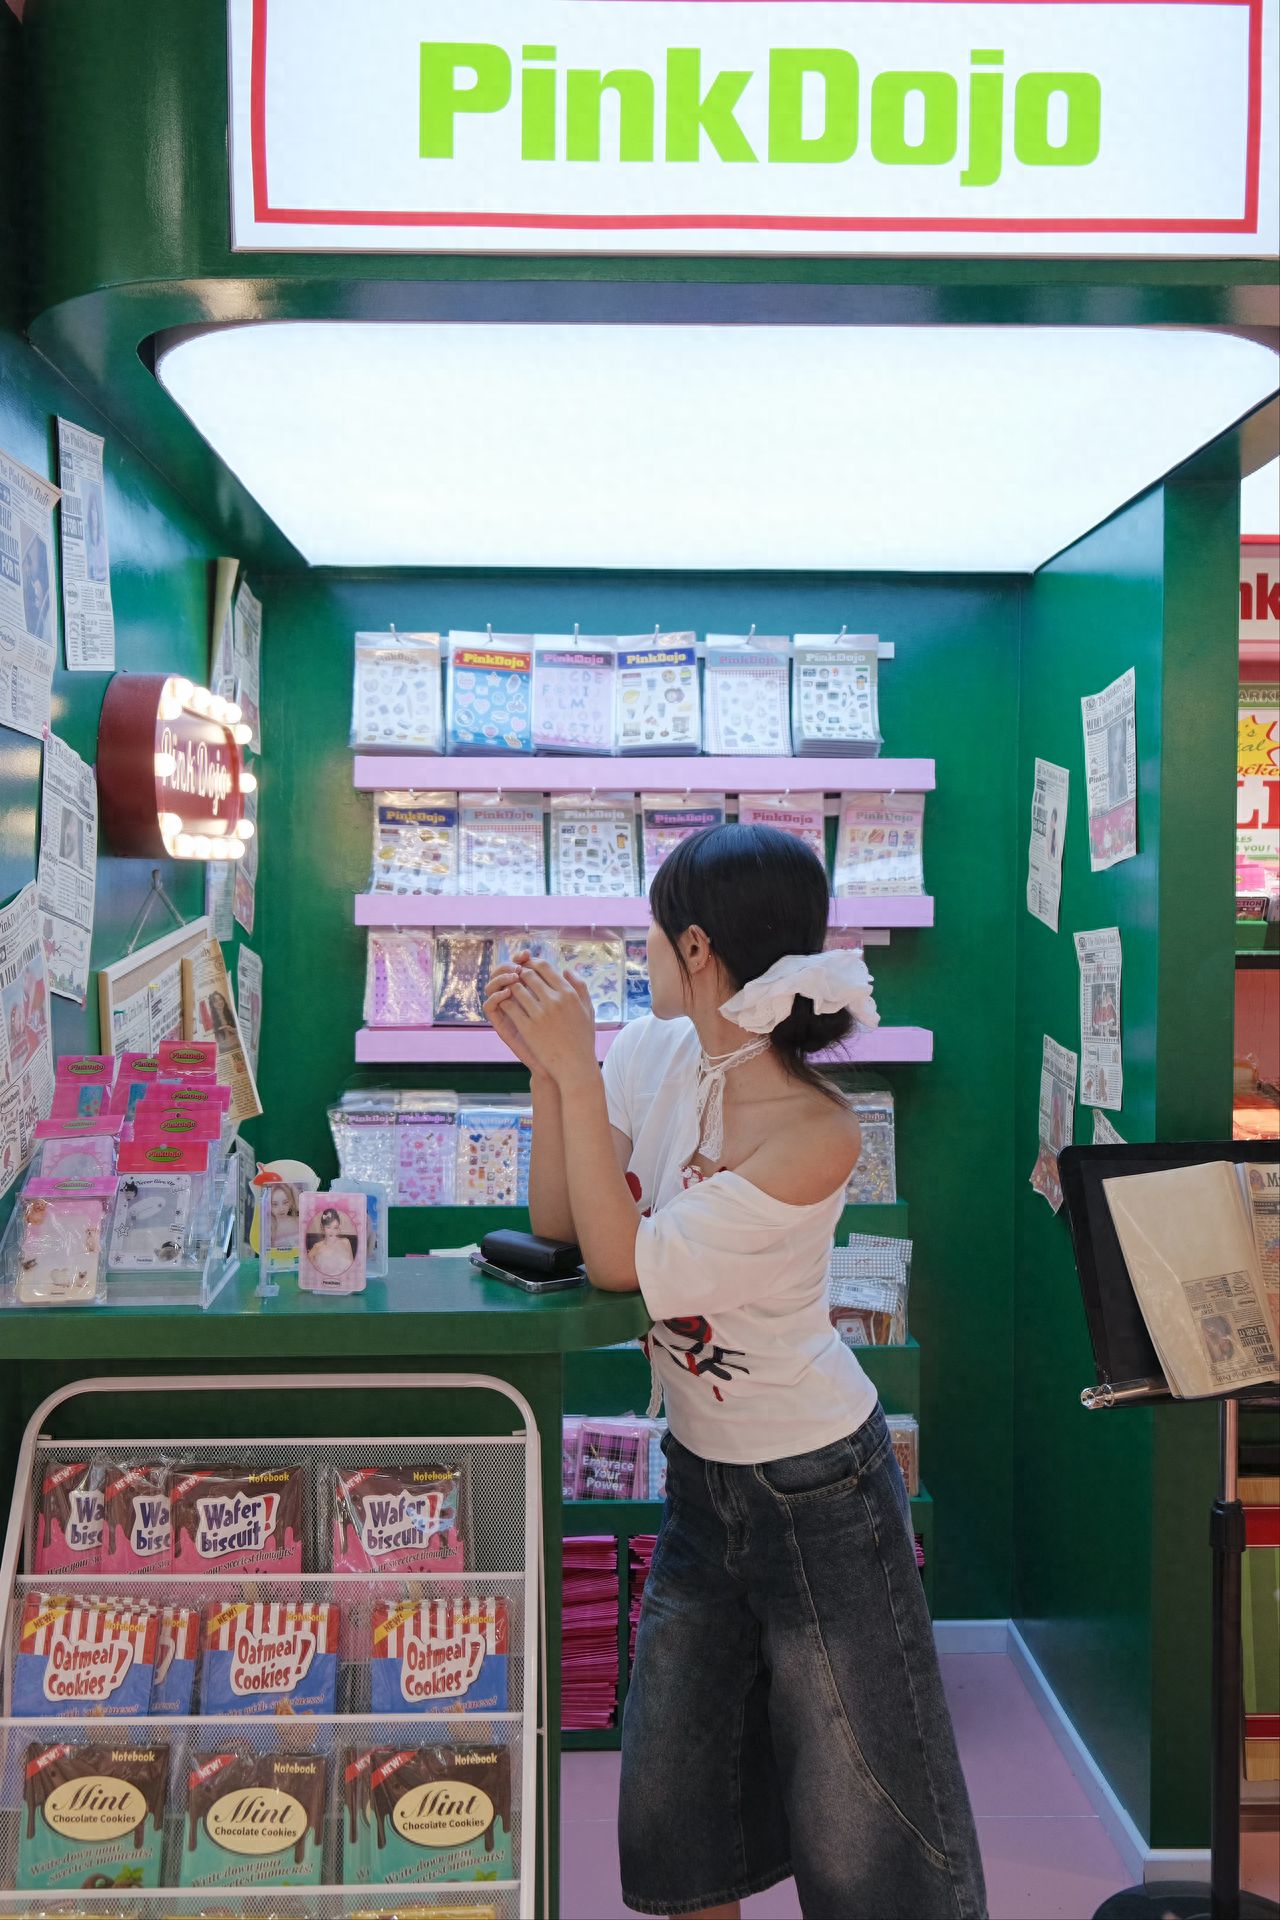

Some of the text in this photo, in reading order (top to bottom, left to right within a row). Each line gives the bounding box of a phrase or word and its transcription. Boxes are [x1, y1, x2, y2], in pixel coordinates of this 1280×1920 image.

[419, 41, 1102, 187] PinkDojo
[463, 653, 525, 669] PinkDojo
[543, 653, 604, 665] PinkDojo
[627, 651, 687, 666] PinkDojo
[805, 651, 867, 664] PinkDojo
[197, 741, 228, 816] Dojo
[387, 810, 447, 823] PinkDojo
[474, 810, 533, 822] PinkDojo
[655, 811, 715, 824] PinkDojo
[752, 811, 814, 824] PinkDojo
[856, 811, 914, 822] PinkDojo
[582, 1455, 634, 1471] Embrace
[51, 1467, 75, 1484] NEW!
[249, 1473, 290, 1484] Notebook
[413, 1472, 453, 1481] Notebook
[594, 1466, 621, 1480] Your
[586, 1477, 625, 1491] Power
[71, 1525, 102, 1545] bisc
[137, 1530, 170, 1550] bisc
[223, 1554, 254, 1570] sweetest
[33, 1612, 55, 1630] NEW!
[217, 1607, 238, 1625] NEW!
[287, 1612, 328, 1622] Notebook
[383, 1613, 404, 1632] NEW!
[105, 1620, 146, 1633] Notebook
[36, 1748, 60, 1768] NEW!
[111, 1751, 155, 1762] Notebook
[455, 1753, 497, 1766] Notebook
[198, 1759, 223, 1779] NEW!
[274, 1763, 317, 1774] Notebook
[381, 1756, 402, 1777] NEW!
[52, 1783, 134, 1811] Mint
[401, 1789, 479, 1818] Mint
[214, 1796, 293, 1824] Mint
[53, 1814, 136, 1823] Chocolate Cookies
[402, 1818, 485, 1831] Chocolate Cookies
[215, 1826, 297, 1837] Chocolate Cookies
[30, 1845, 121, 1877] Write down your
[49, 1847, 154, 1882] sweetest moments!
[224, 1862, 254, 1878] down
[255, 1859, 283, 1872] your
[384, 1865, 415, 1884] Write
[416, 1854, 446, 1873] down
[447, 1849, 474, 1863] your
[448, 1850, 506, 1871] moments!
[256, 1863, 315, 1881] moments!
